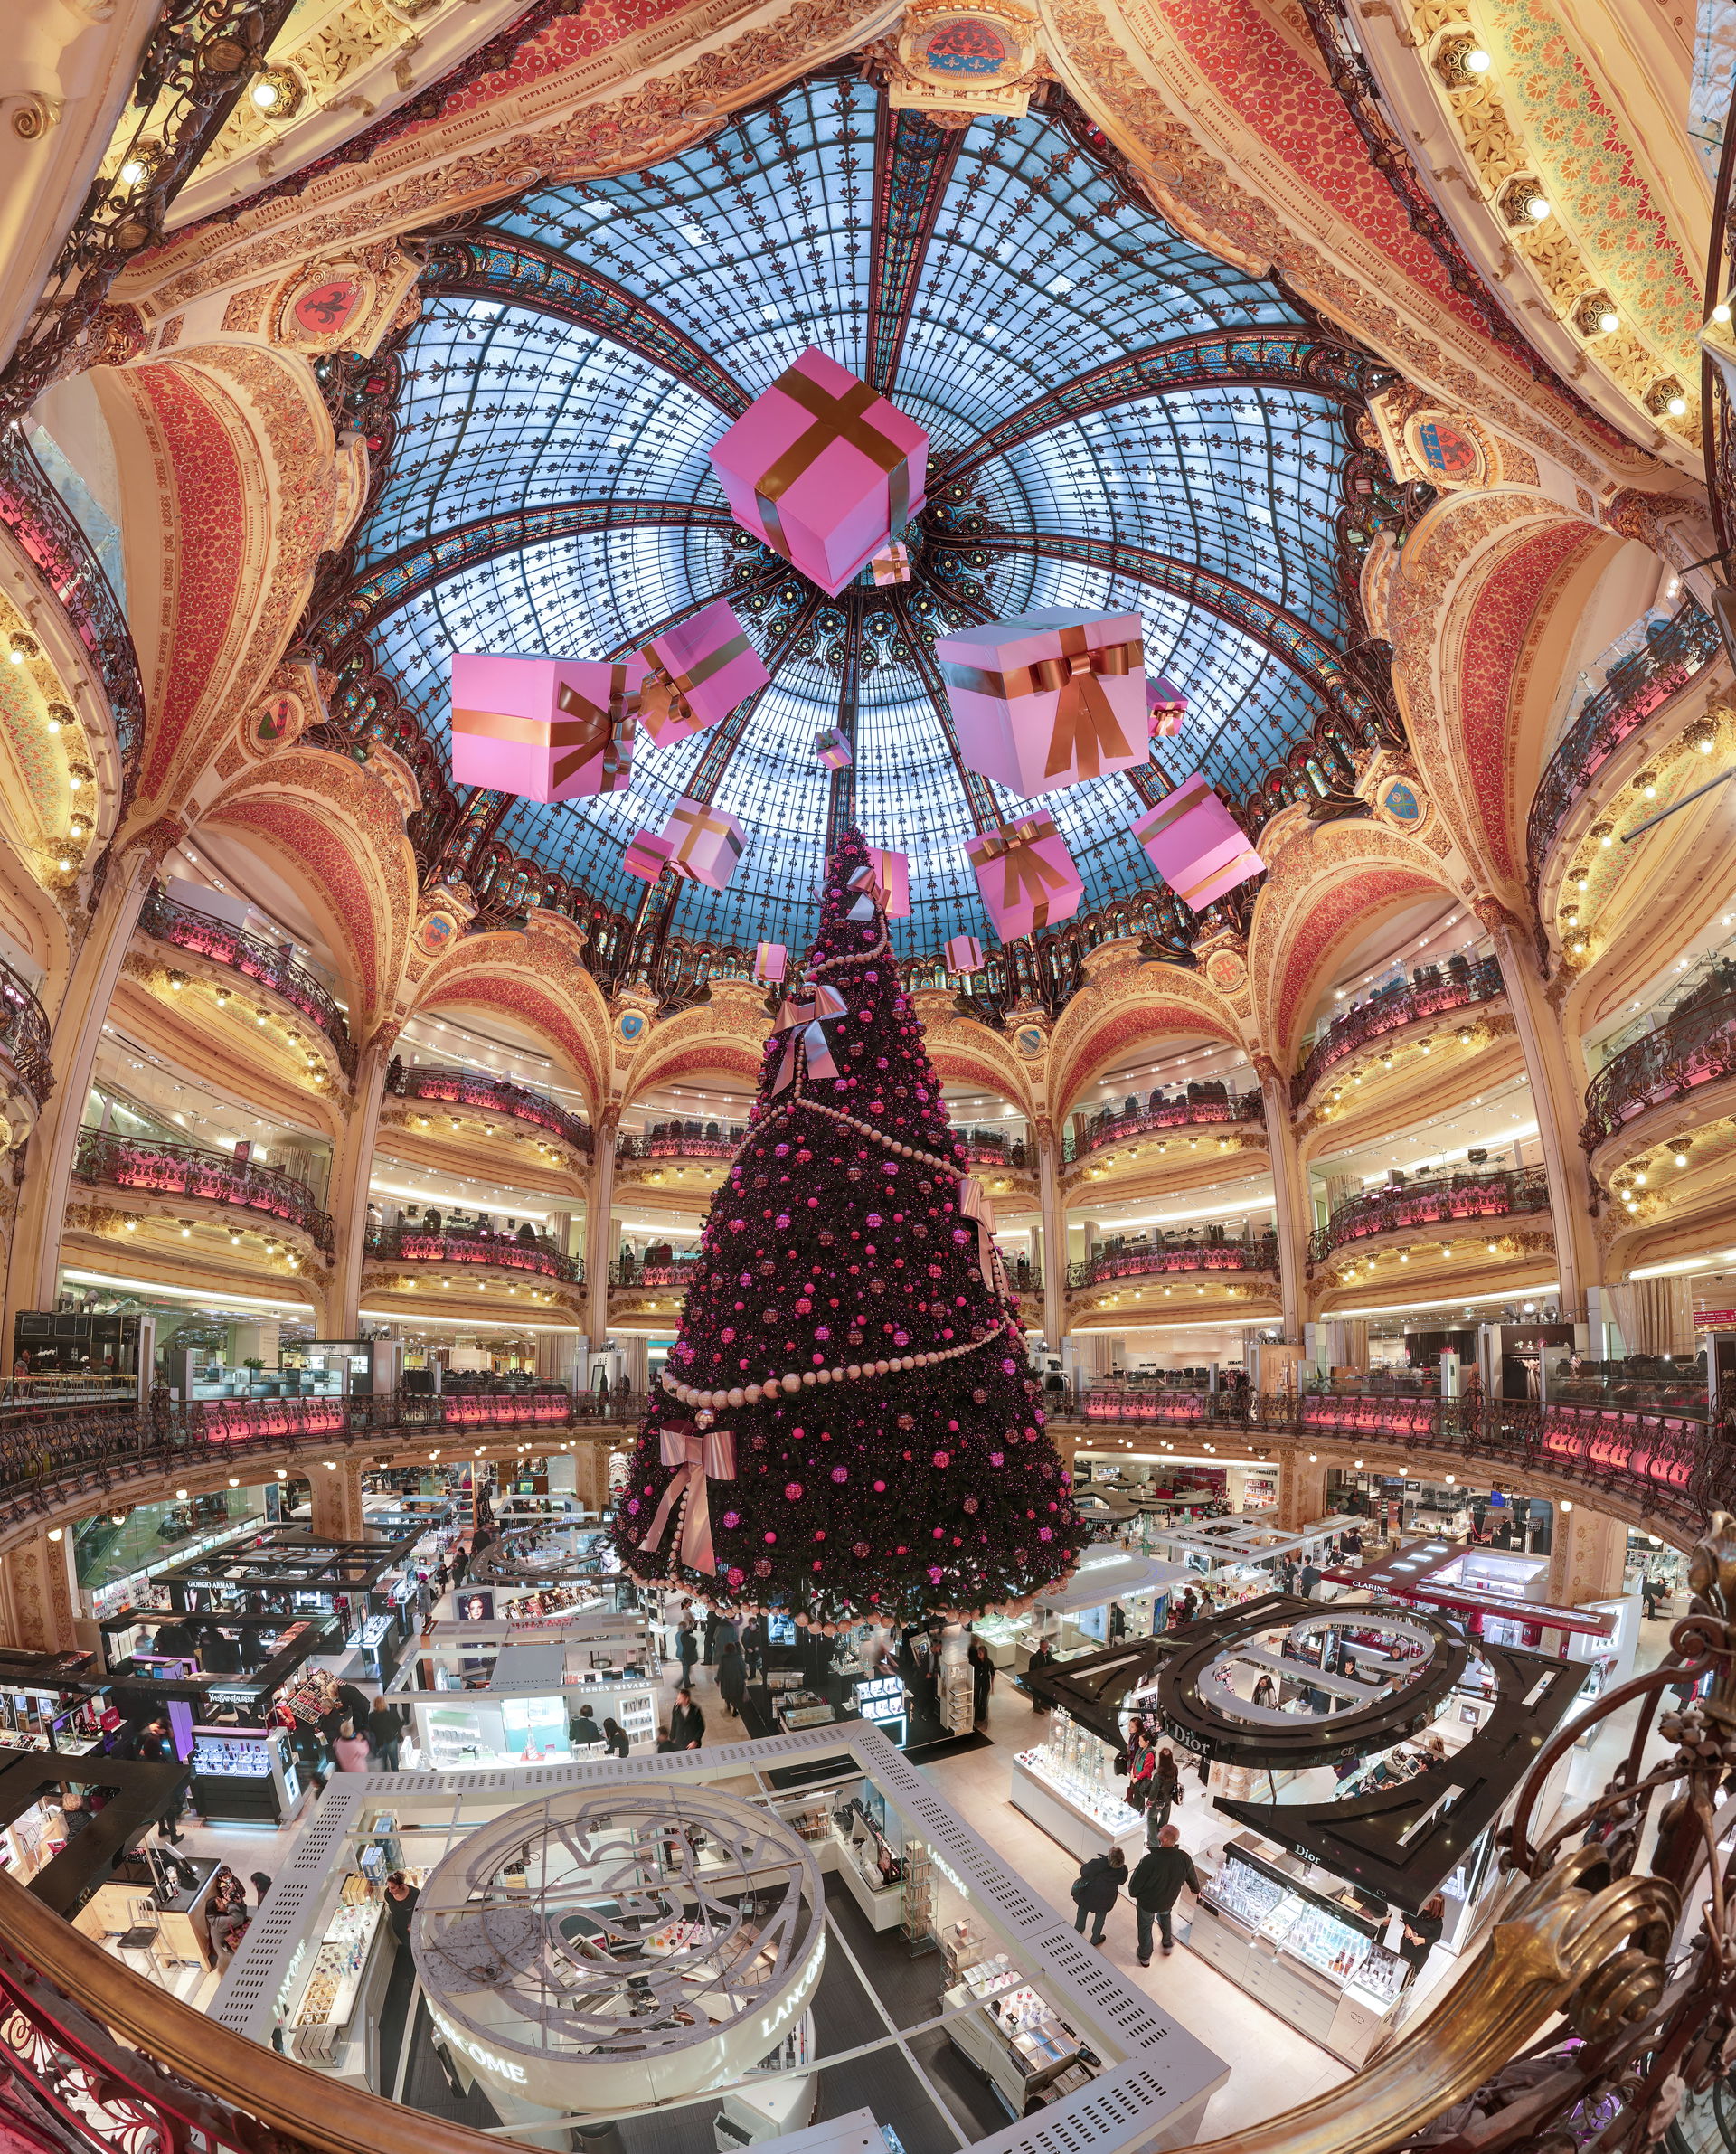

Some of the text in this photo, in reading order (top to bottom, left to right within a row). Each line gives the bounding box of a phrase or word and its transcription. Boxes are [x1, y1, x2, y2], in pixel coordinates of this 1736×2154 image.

[187, 1581, 236, 1590] GIORGIO ARMANI
[1352, 1581, 1389, 1593] CLARINS
[580, 1681, 653, 1694] ISSEY MIYAKE
[1057, 1704, 1071, 1718] Dior
[1174, 1723, 1211, 1755] Dior
[1341, 1746, 1355, 1757] CD
[1294, 1843, 1321, 1865] Dior
[1376, 1888, 1387, 1898] CD
